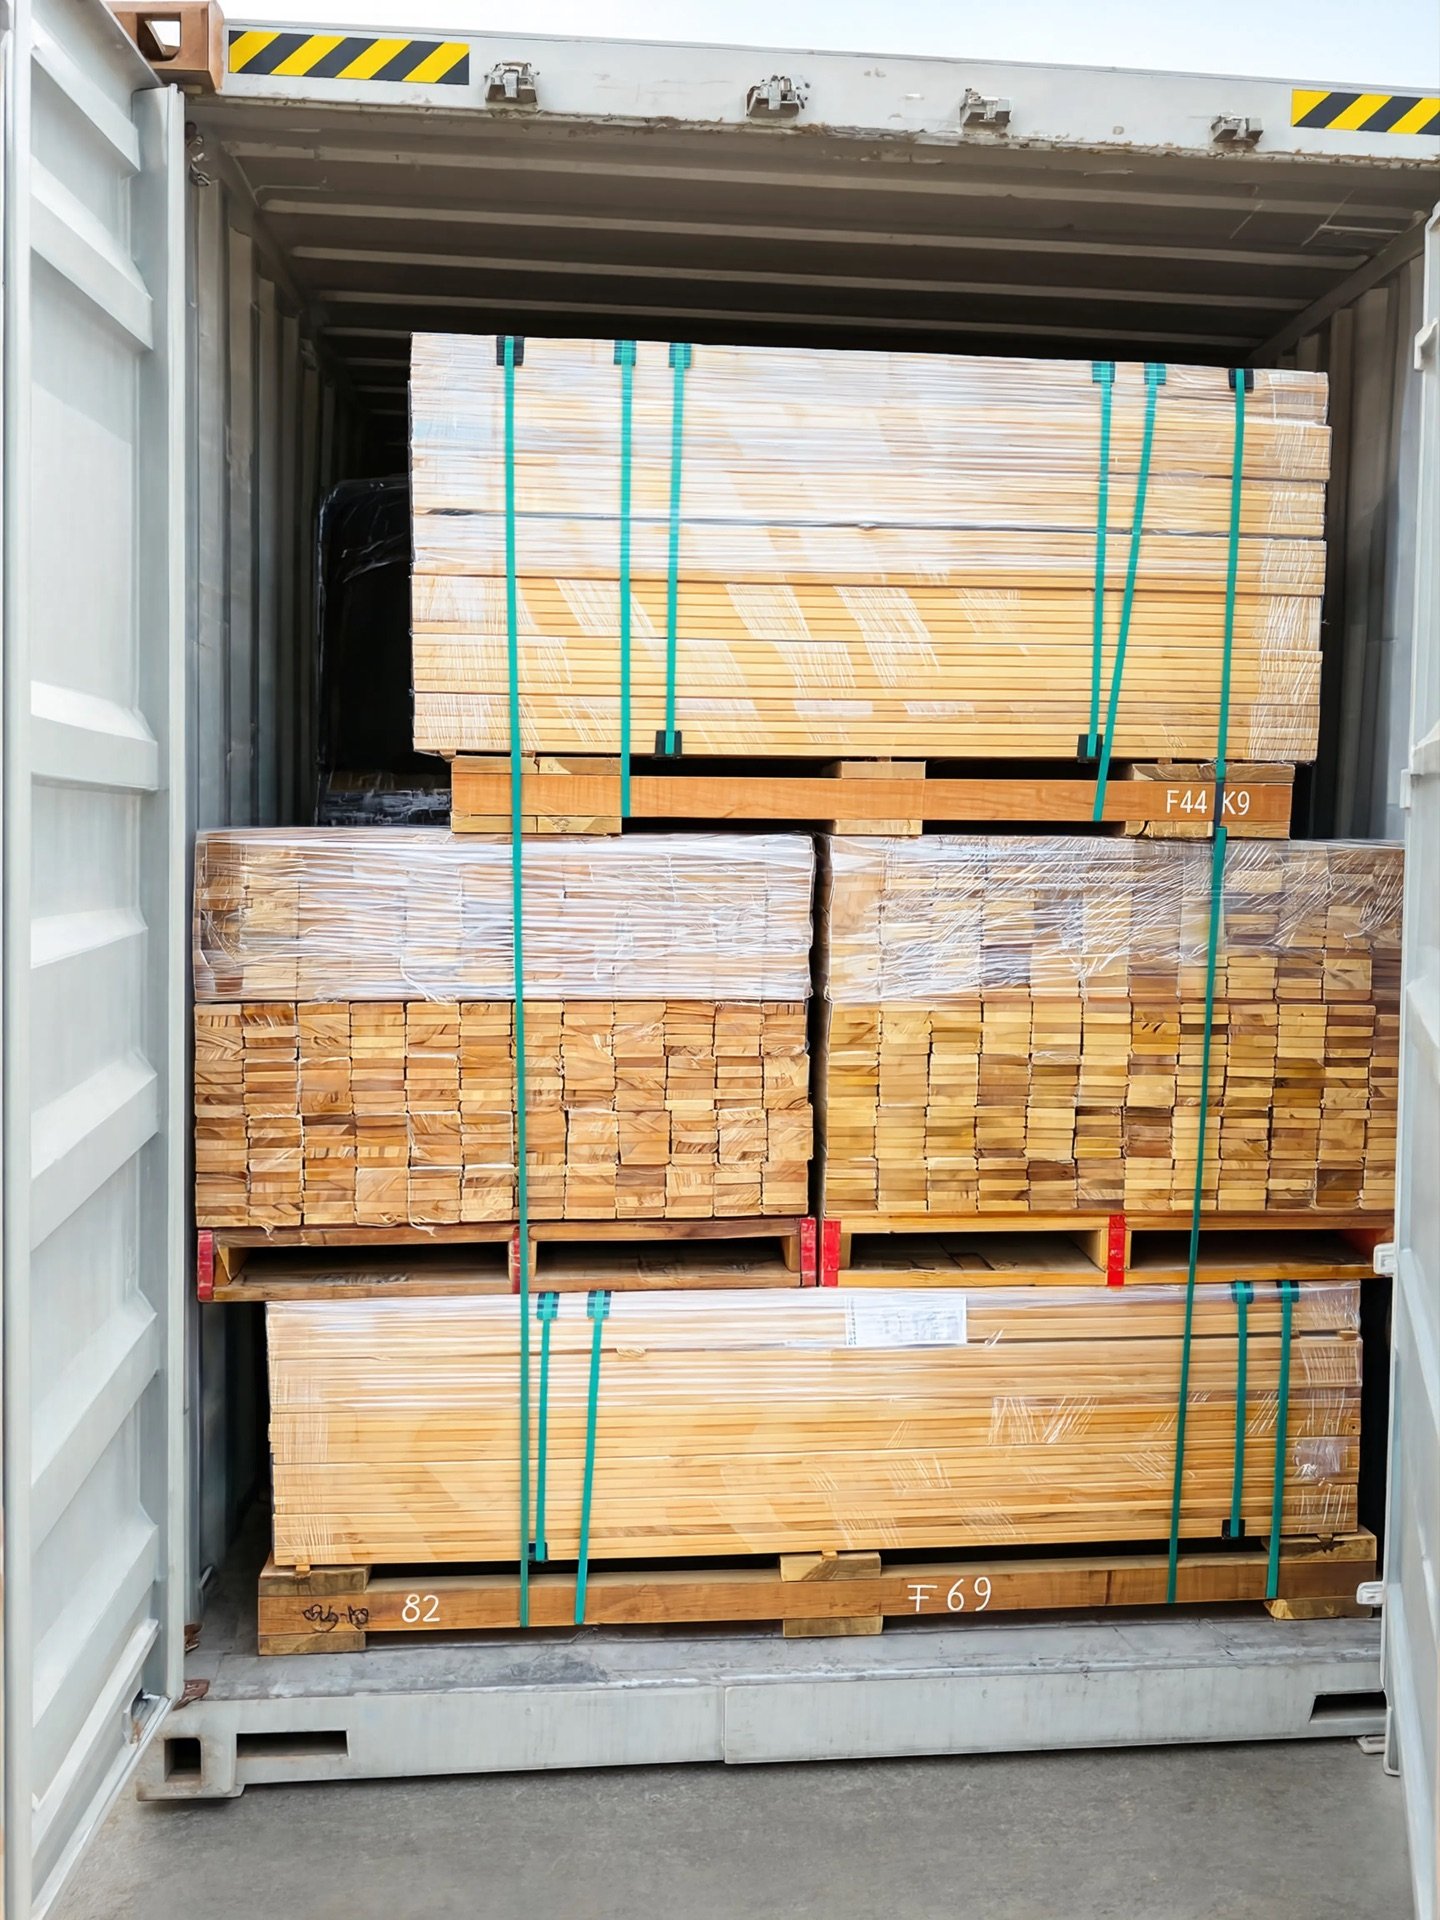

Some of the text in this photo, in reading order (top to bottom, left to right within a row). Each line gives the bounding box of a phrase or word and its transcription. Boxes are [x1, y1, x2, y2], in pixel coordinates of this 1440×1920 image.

[1166, 789, 1250, 816] F44 K9
[401, 1593, 440, 1623] 82
